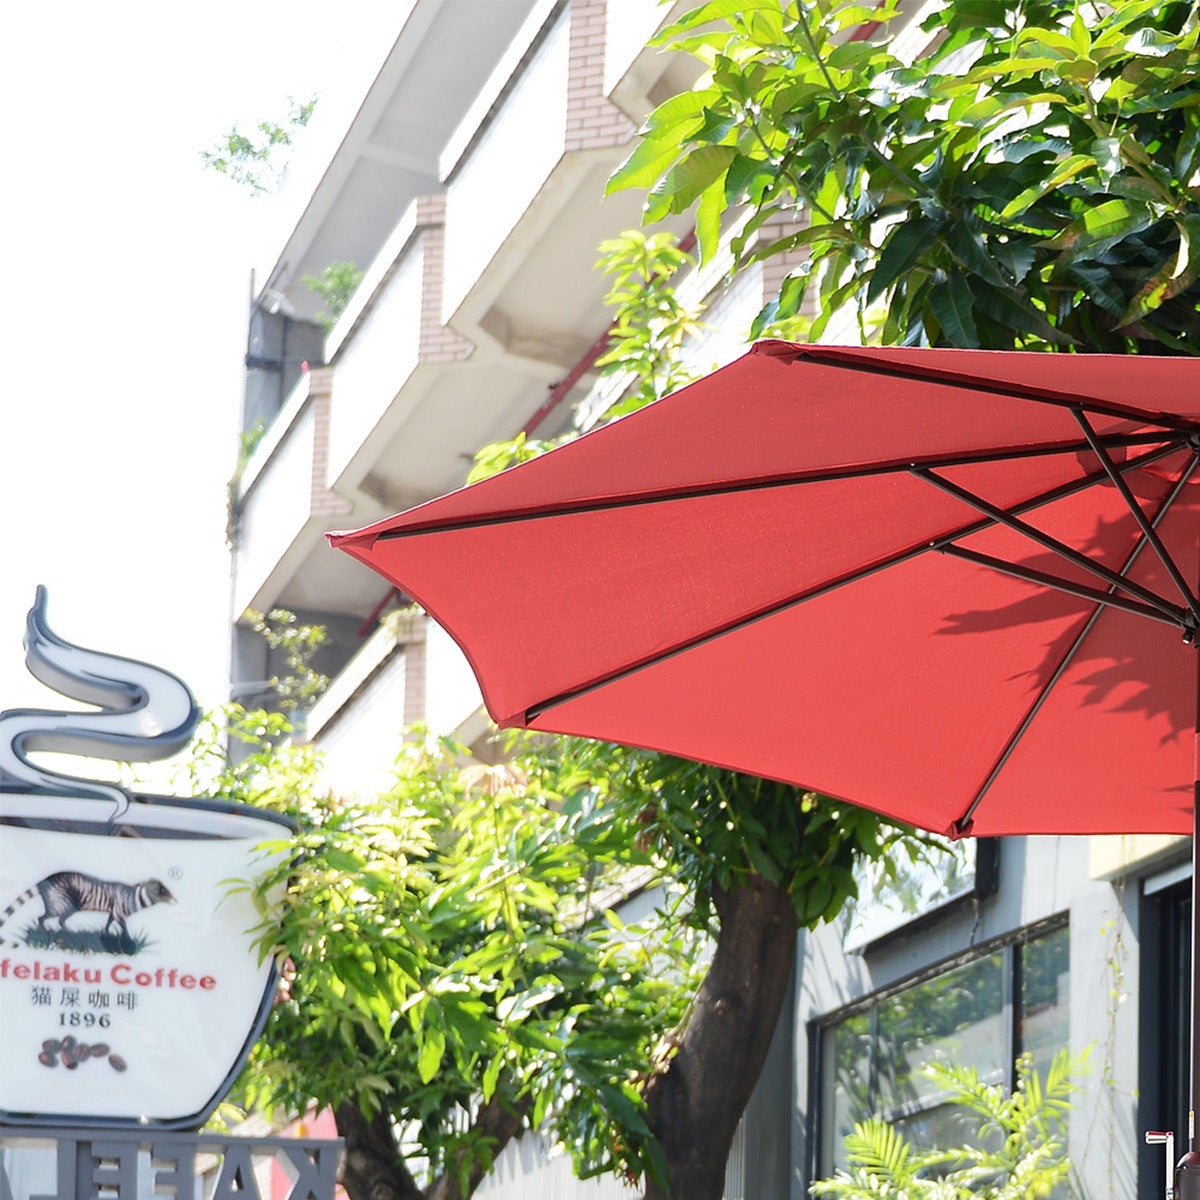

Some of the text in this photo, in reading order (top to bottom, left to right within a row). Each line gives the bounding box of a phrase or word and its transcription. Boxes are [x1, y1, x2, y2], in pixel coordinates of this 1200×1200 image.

[0, 959, 217, 990] felaku Coffee
[31, 985, 138, 1010] 猫屎咖啡
[59, 1012, 111, 1029] 1896
